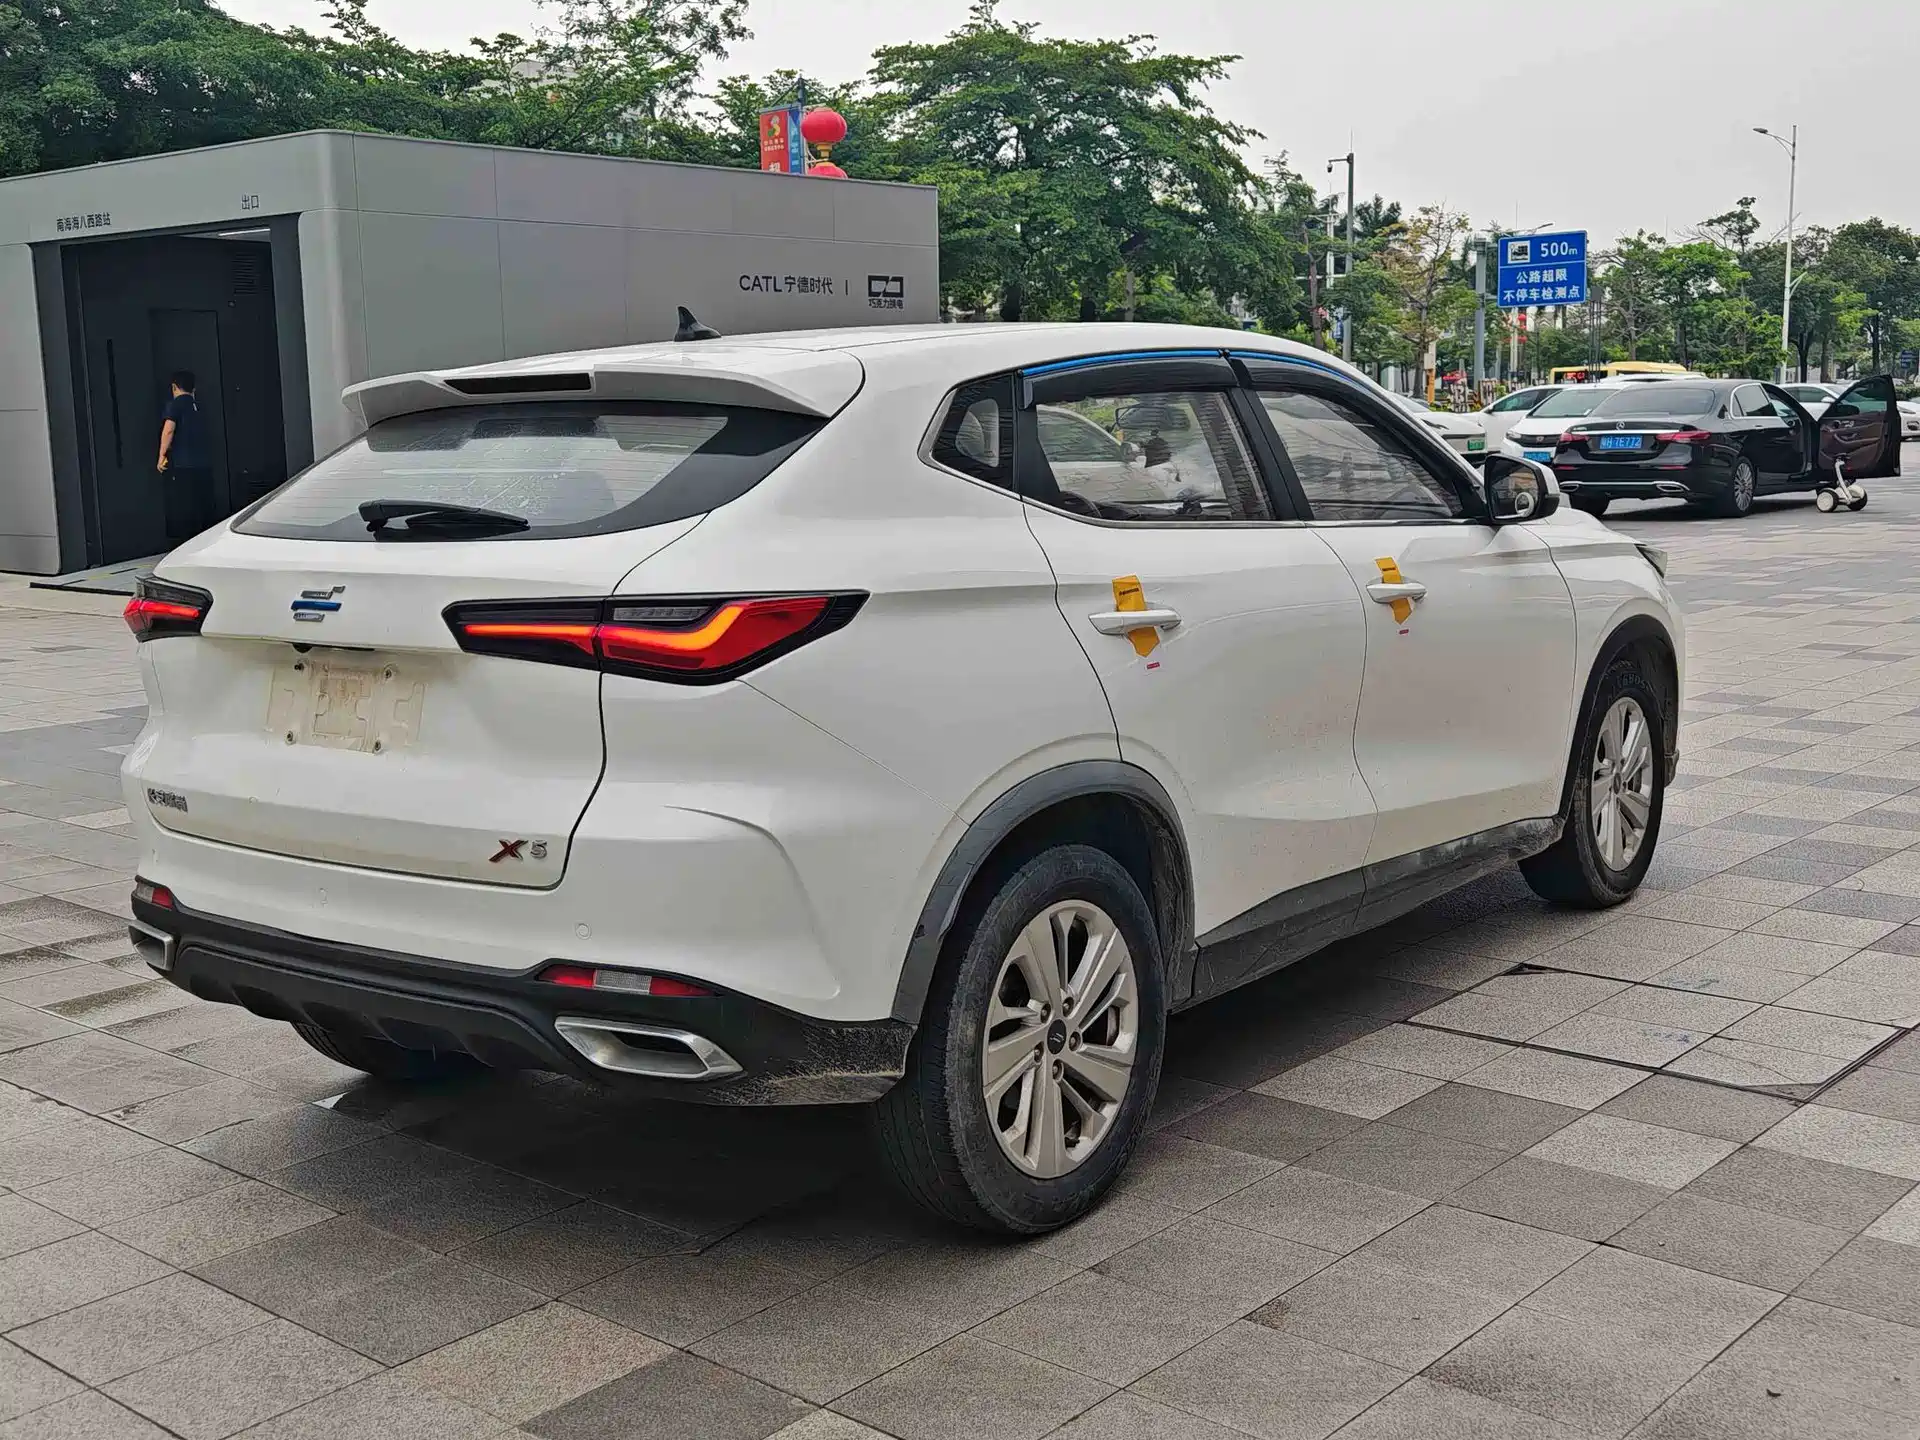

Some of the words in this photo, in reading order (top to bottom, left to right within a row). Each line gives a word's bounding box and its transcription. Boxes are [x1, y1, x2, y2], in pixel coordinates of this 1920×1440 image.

[241, 194, 259, 210] 出口
[56, 212, 111, 232] 南海海八西路站
[1540, 241, 1578, 258] 500m
[1516, 268, 1568, 284] 公路超限
[1503, 285, 1580, 302] 不停车检测点
